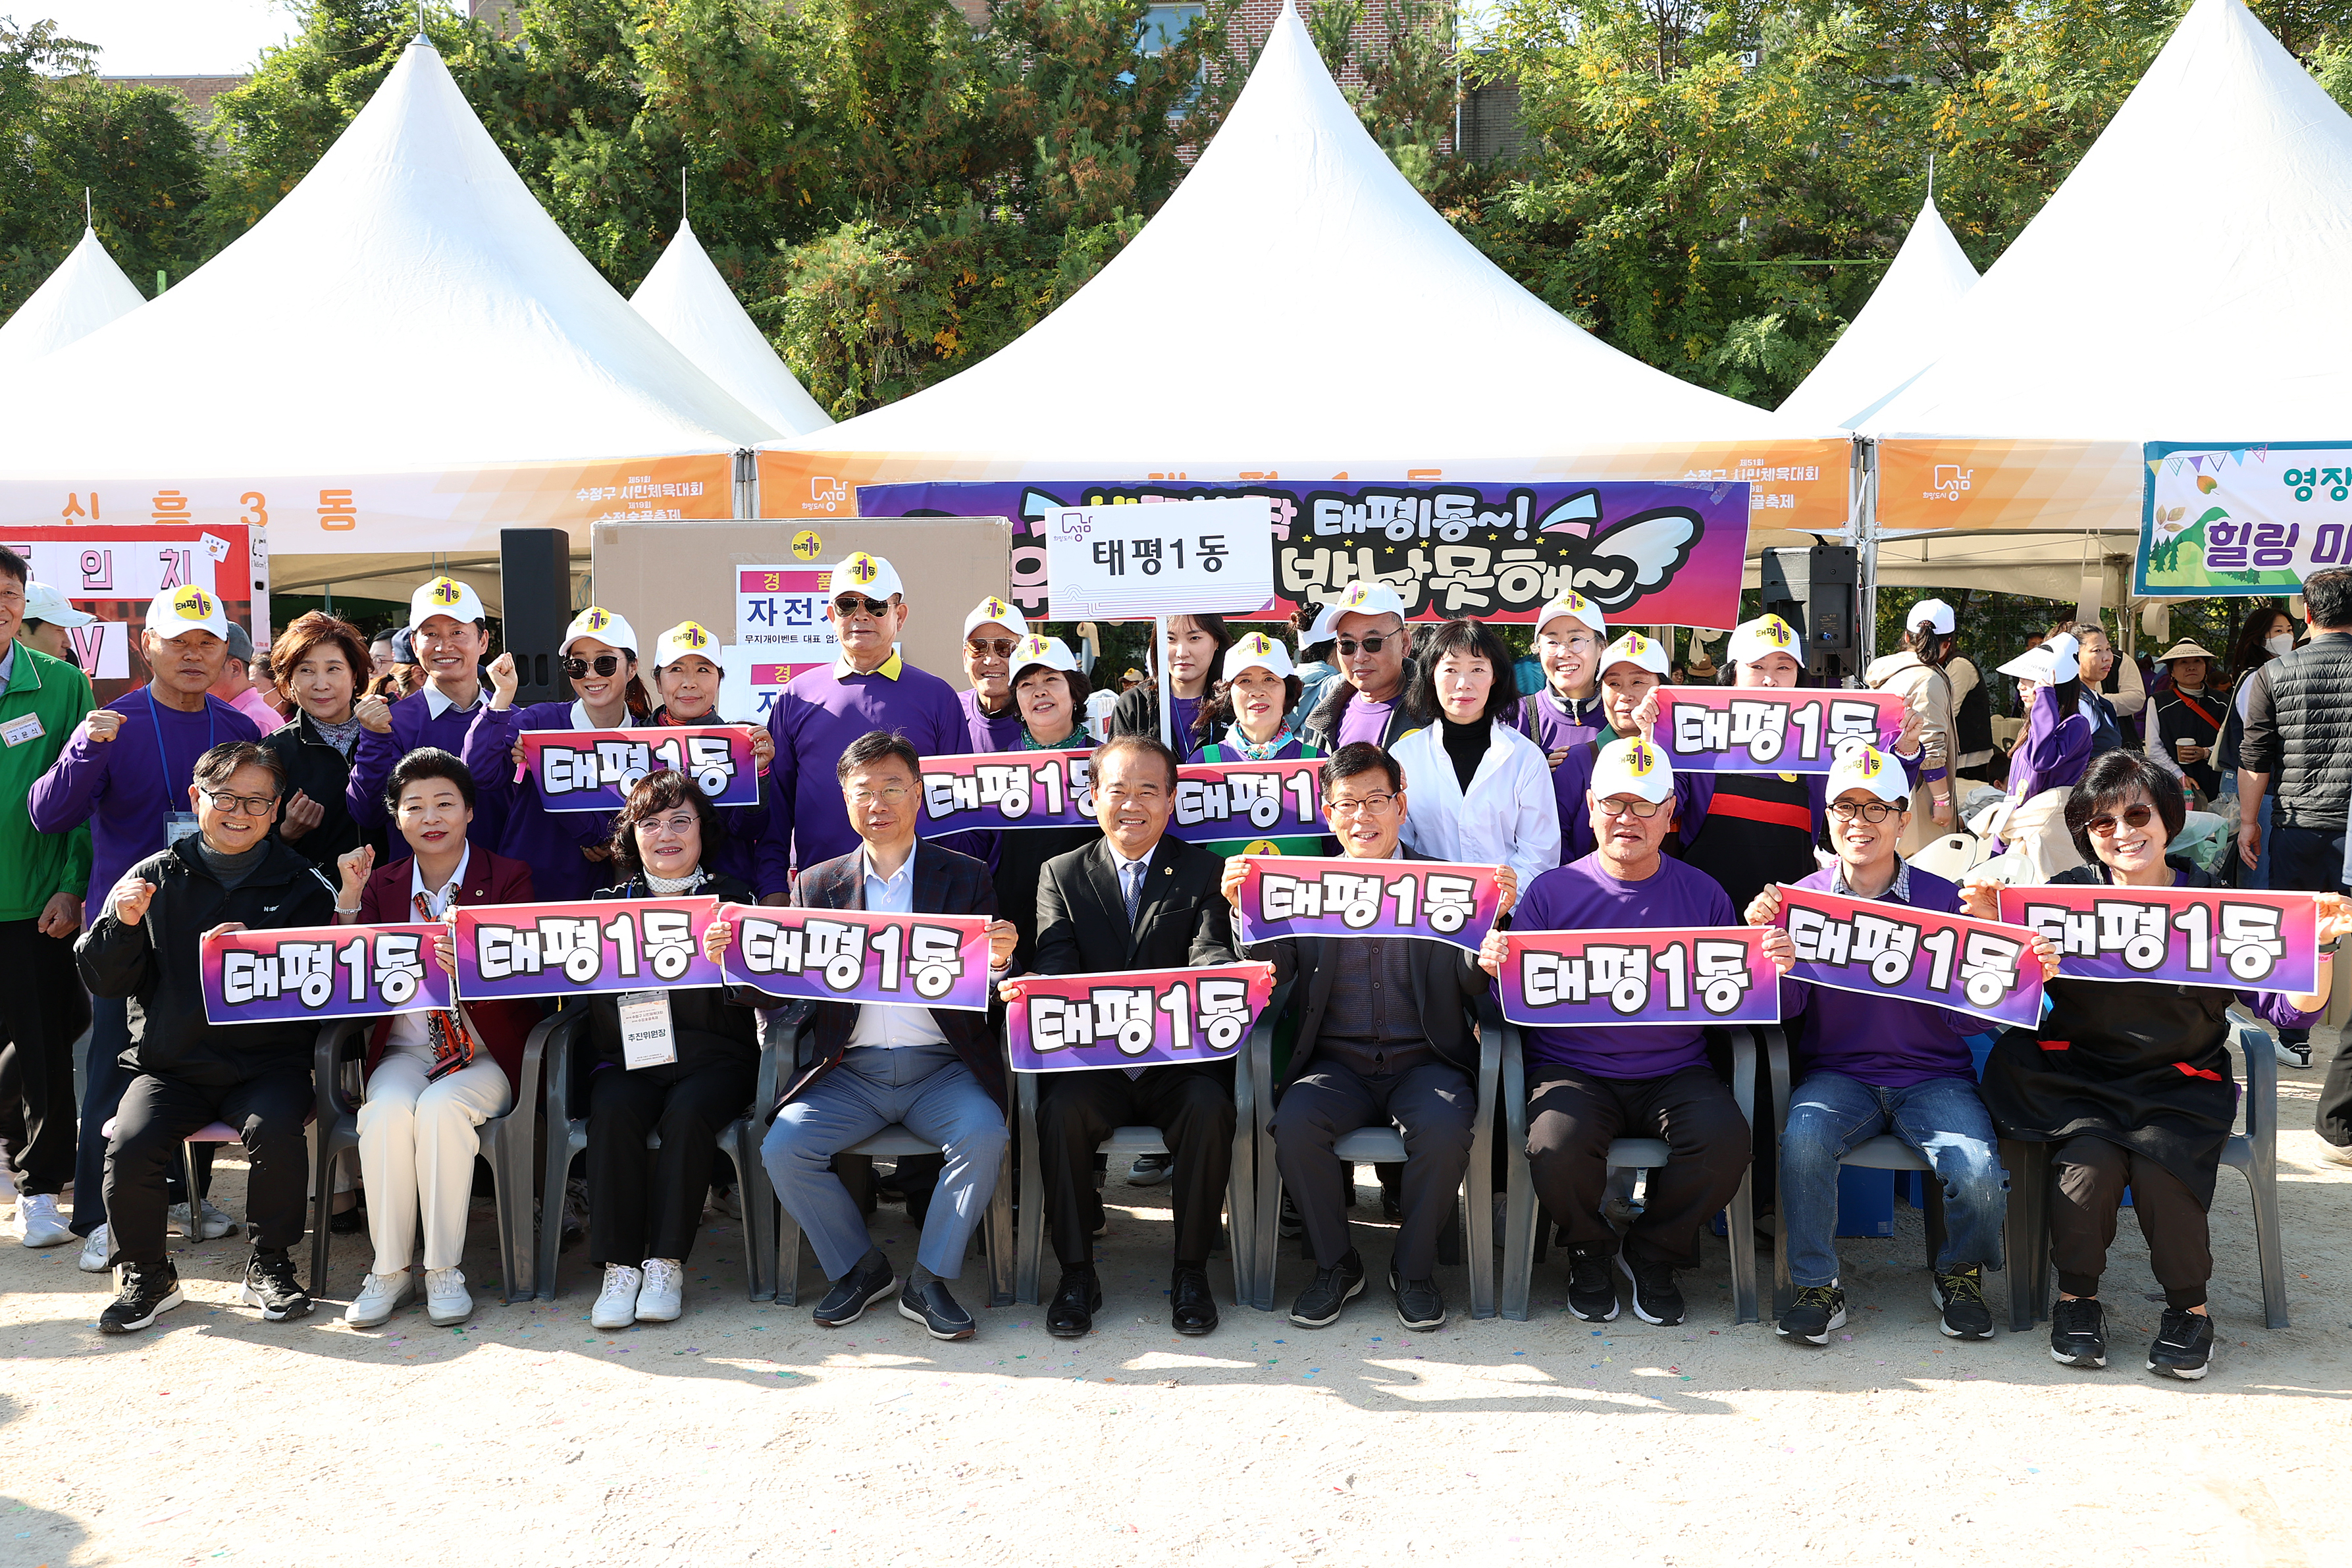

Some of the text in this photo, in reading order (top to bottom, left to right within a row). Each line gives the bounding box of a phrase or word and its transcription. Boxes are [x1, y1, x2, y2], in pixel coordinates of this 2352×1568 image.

[576, 481, 704, 502] 수정구 시민체육대회
[628, 475, 650, 484] 제51회
[1734, 466, 1819, 483] 시민체육대회
[628, 501, 651, 510] 제19회
[793, 536, 820, 556] 태평1동
[1093, 535, 1229, 576] 태평1동
[2207, 521, 2300, 567] 힐링
[175, 592, 211, 616] 태평1동
[745, 635, 798, 644] 무지개이벤트
[803, 635, 821, 644] 대표
[1259, 871, 1477, 934] 태평1동
[475, 909, 698, 984] 태평1동
[739, 916, 965, 1000] 태평1동
[1787, 903, 2021, 1008] 태평1동
[2025, 899, 2287, 982] 태평1동
[222, 933, 425, 1009] 태평1동
[1520, 938, 1752, 1016] 태평1동
[627, 1028, 666, 1041] 추진위원장
[1026, 977, 1253, 1056] 태평1동
